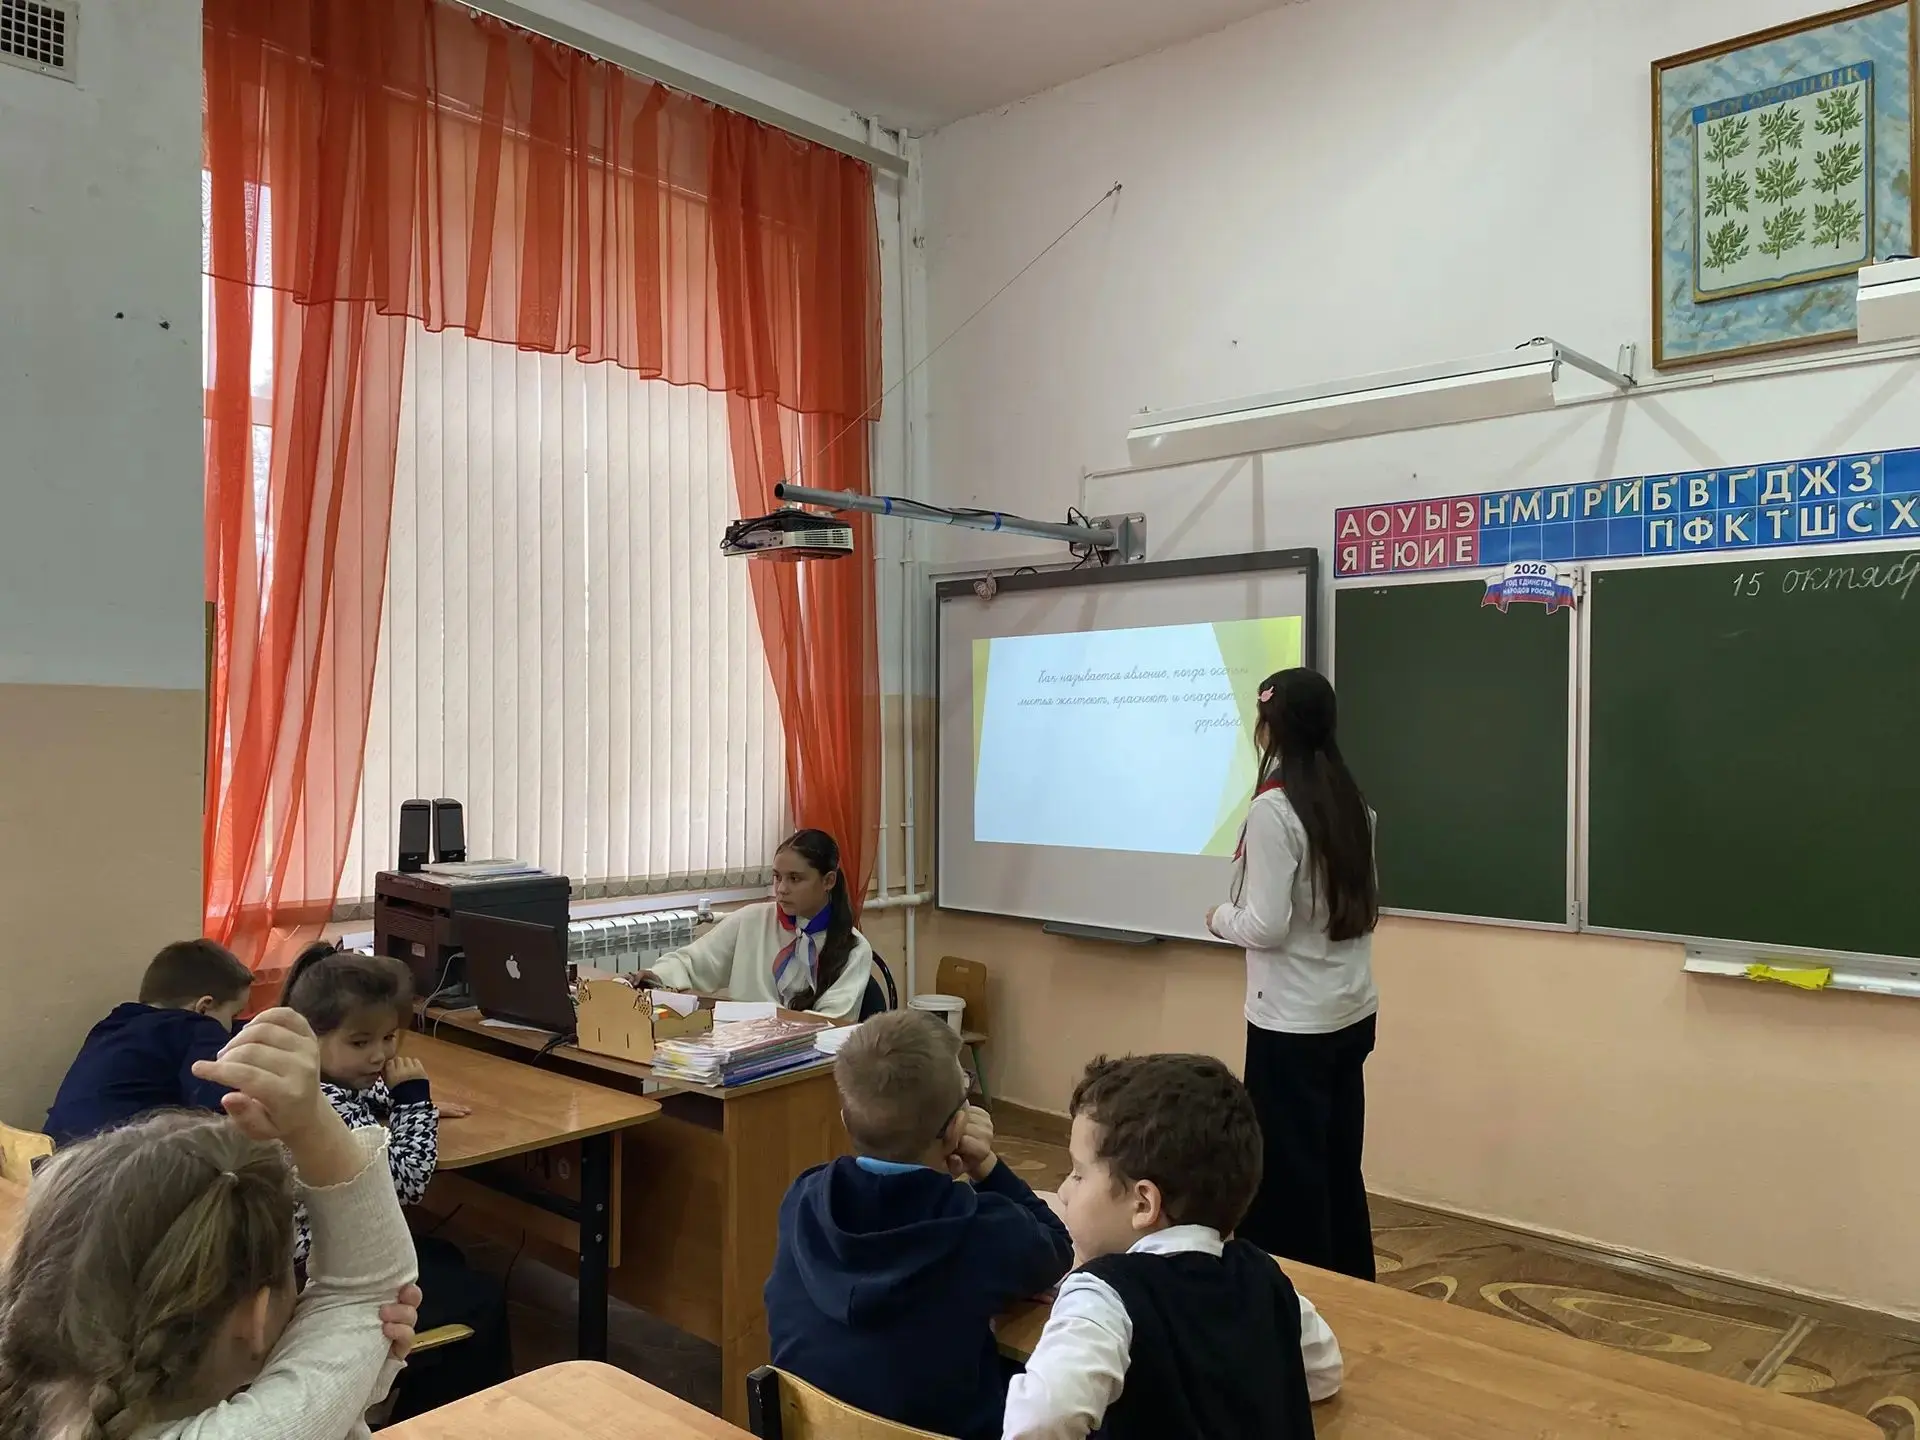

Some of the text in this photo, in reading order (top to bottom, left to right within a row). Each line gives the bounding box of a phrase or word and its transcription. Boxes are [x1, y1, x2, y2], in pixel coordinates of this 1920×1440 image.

[1513, 563, 1547, 575] 2026
[1505, 578, 1553, 588] ГОД ЕДИНСТВА
[1732, 570, 1765, 597] 15
[1503, 587, 1555, 597] НАРОДОВ РОССИИ
[1037, 669, 1058, 683] Как
[1060, 667, 1121, 687] называется
[1173, 667, 1206, 683] когда
[1172, 694, 1181, 703] и
